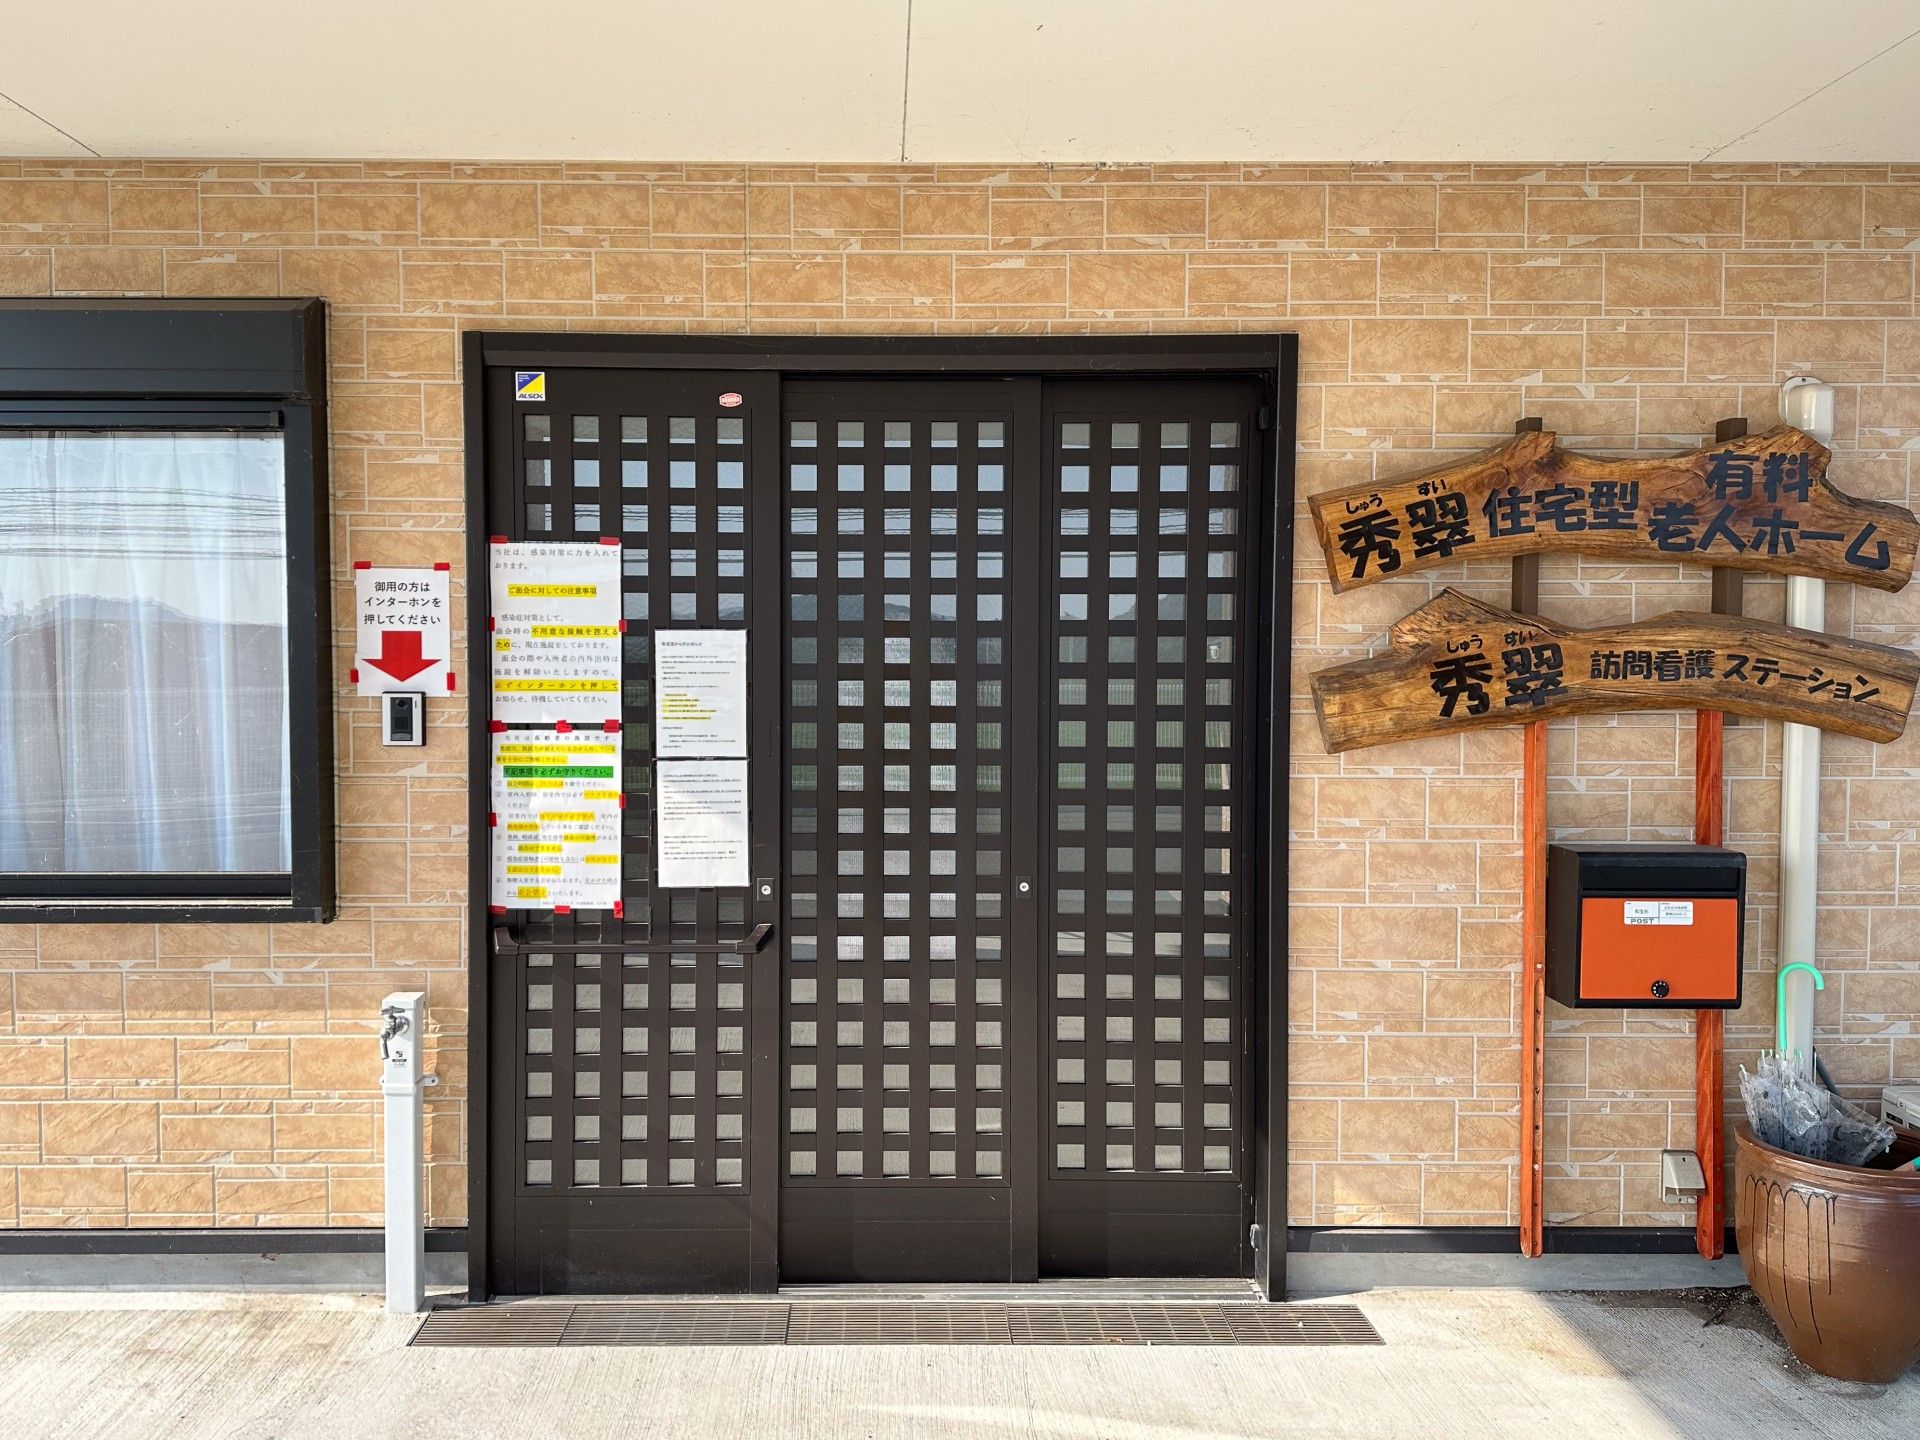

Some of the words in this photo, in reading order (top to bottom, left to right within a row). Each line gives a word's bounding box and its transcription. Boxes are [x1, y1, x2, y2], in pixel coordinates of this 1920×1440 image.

[1705, 450, 1814, 503] 有料
[1346, 494, 1383, 515] しゅう
[1416, 479, 1447, 496] すい
[1338, 491, 1476, 579] 秀翠
[1482, 481, 1640, 538] 住宅型
[1648, 501, 1891, 571] 老人ホーム
[494, 548, 618, 557] 当社は、感染対策に力を入れて
[494, 562, 528, 570] おります。
[374, 581, 431, 593] 御用の方は
[508, 587, 597, 595] ご面会に対しての注意事項
[364, 596, 442, 608] インターホンを
[363, 613, 441, 625] 押してください
[496, 640, 611, 649] ために、現在施錠をしております。
[1446, 634, 1483, 654] しゅう
[1503, 630, 1537, 647] すい
[494, 668, 615, 677] 施錠を解除いたしますので、
[494, 682, 618, 690] 必ずインターホンを押して
[1429, 642, 1569, 718] 秀翠
[1590, 649, 1881, 703] 訪問看護ステーション
